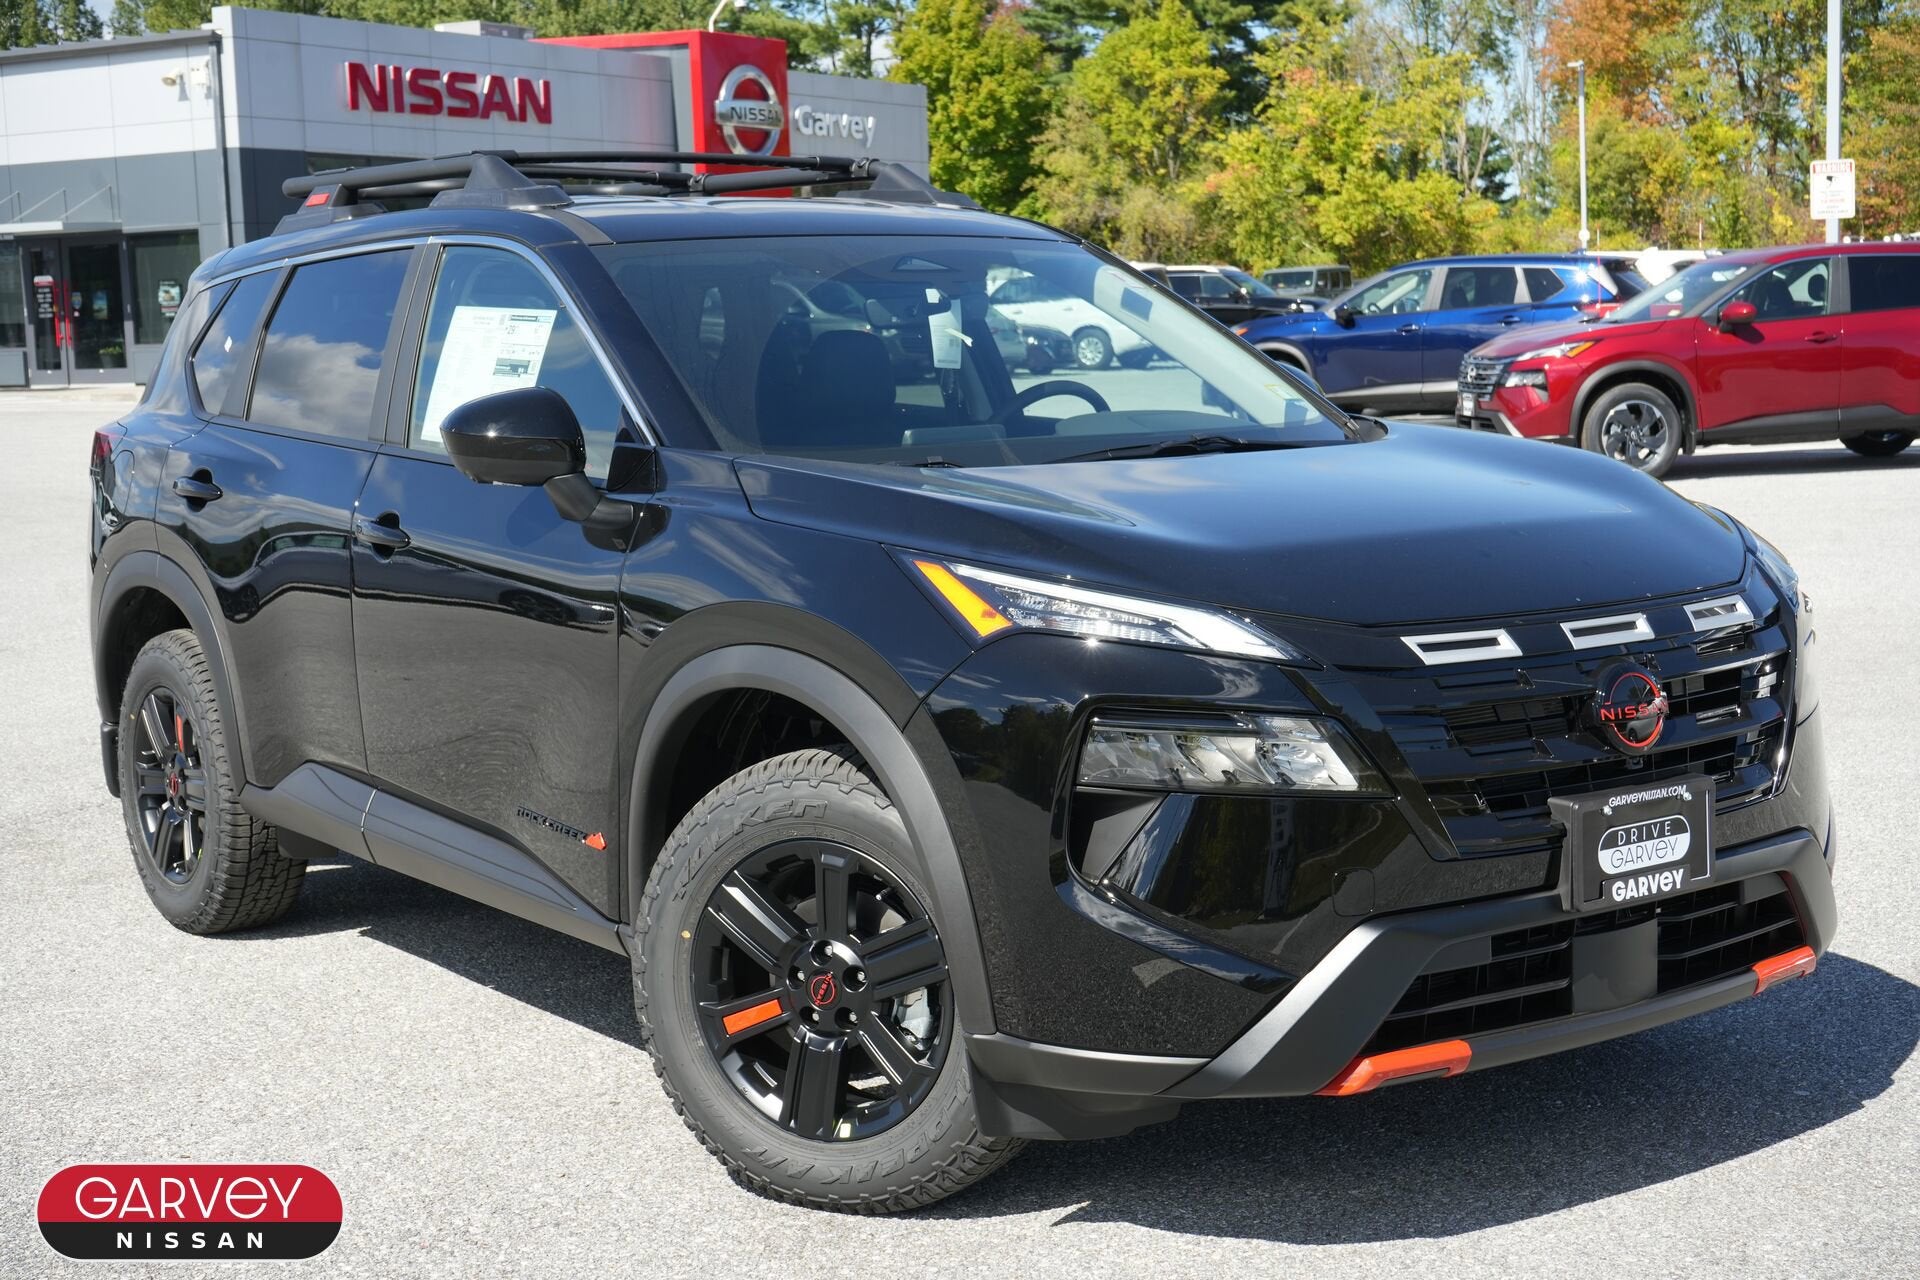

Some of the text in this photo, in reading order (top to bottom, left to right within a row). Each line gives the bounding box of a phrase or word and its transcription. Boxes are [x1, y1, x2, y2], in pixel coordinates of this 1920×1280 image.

[345, 61, 552, 124] NISSAN
[730, 106, 782, 122] NISSAN
[794, 105, 877, 148] Garvey
[1601, 701, 1668, 721] NISSAN
[1608, 785, 1687, 808] GARVEYNISSAN.COM
[1617, 821, 1672, 846] DRIVE
